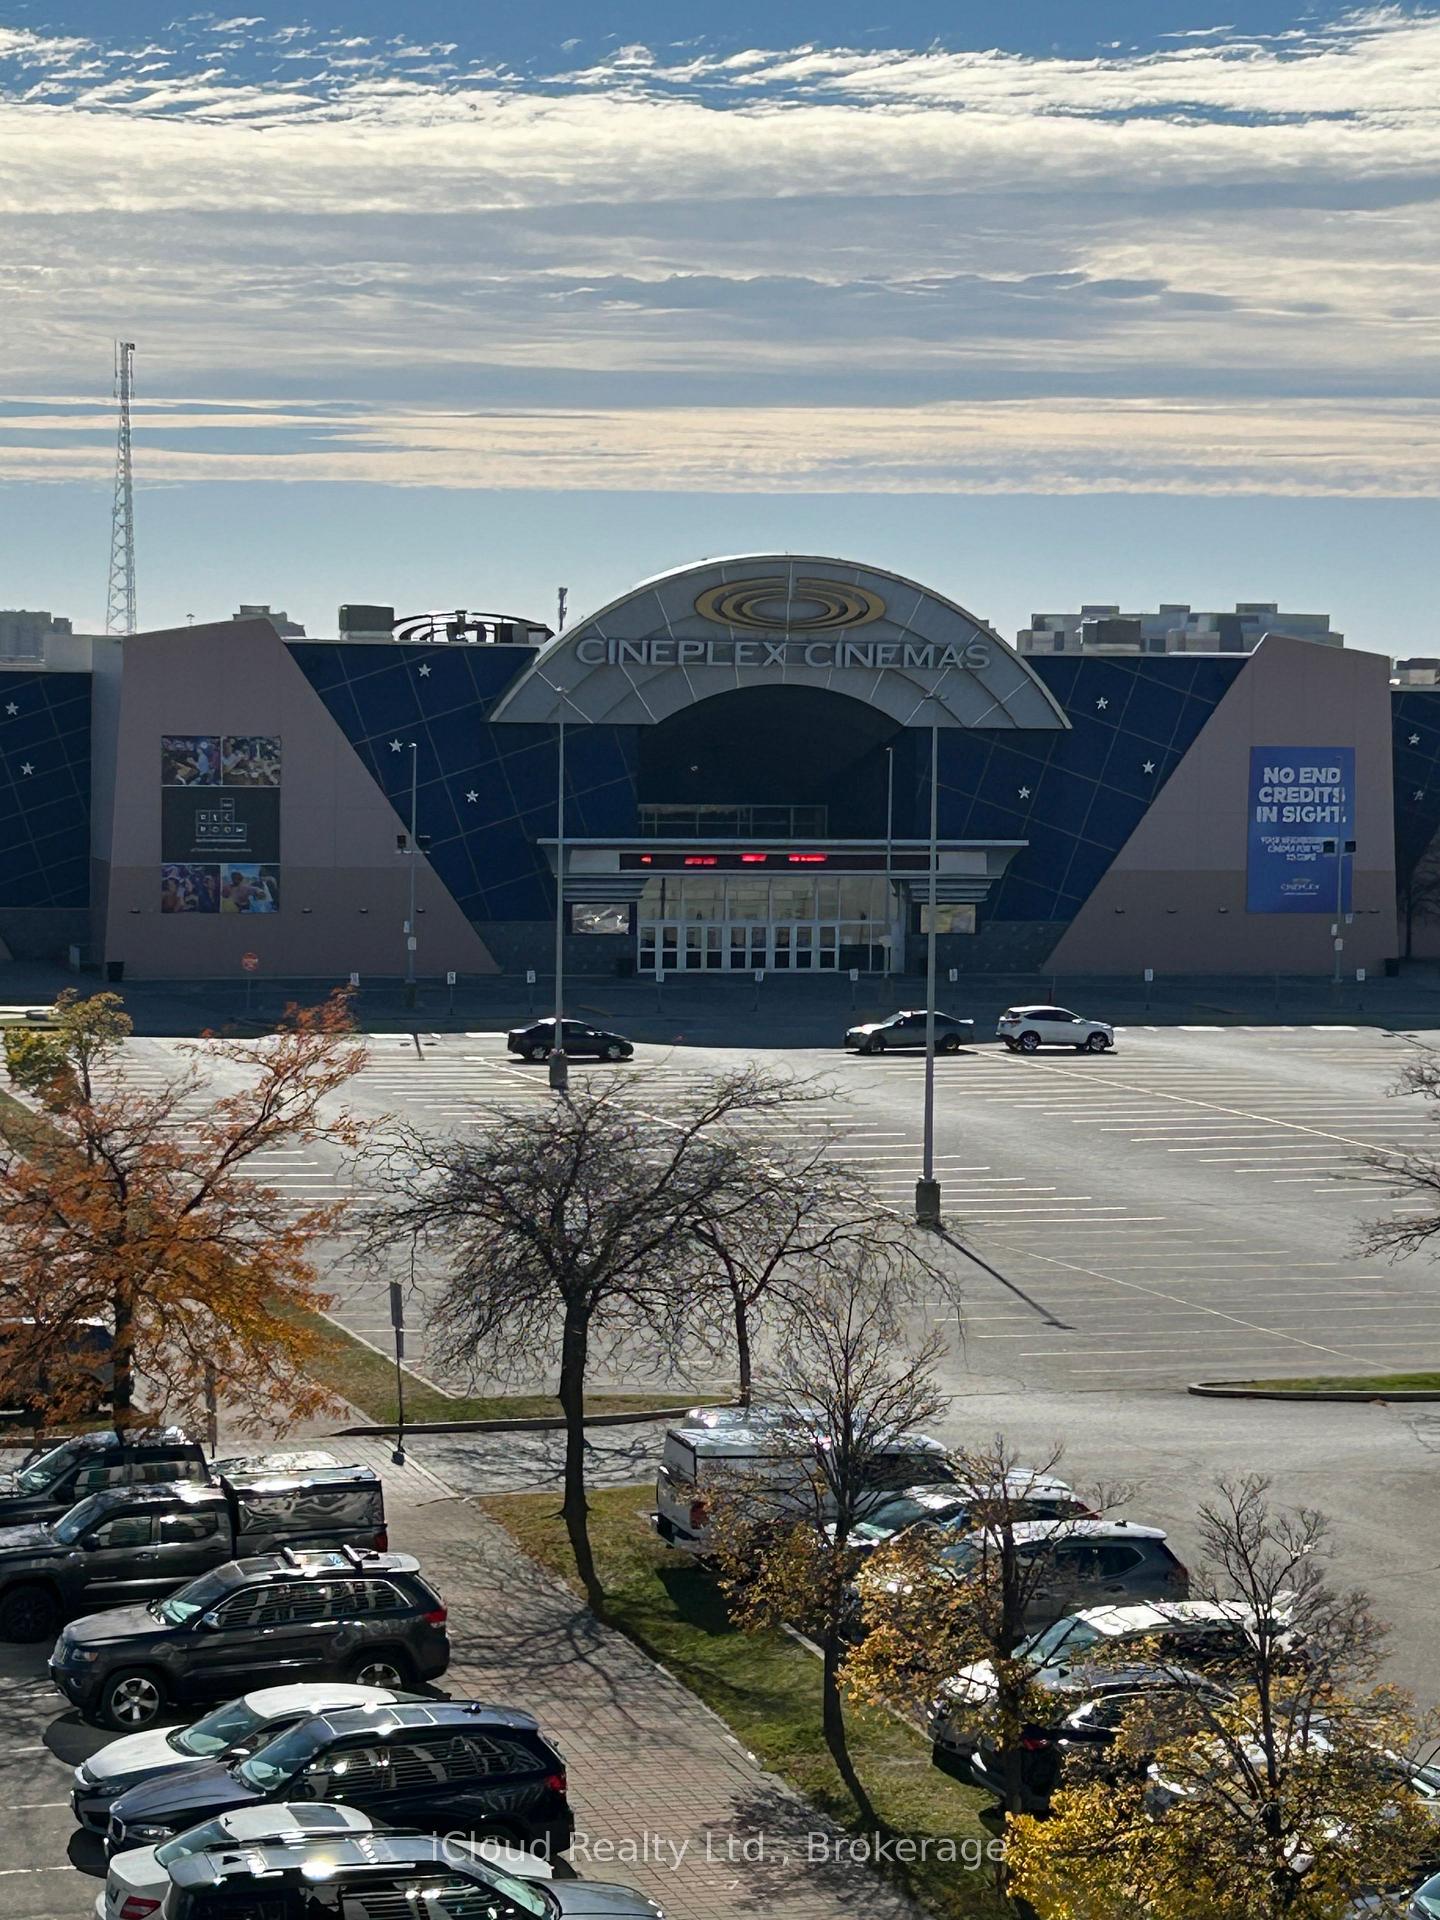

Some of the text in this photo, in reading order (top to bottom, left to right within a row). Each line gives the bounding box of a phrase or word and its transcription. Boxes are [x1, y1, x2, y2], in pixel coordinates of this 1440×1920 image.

[575, 637, 992, 670] CINEPLEX CINEMAS
[1263, 767, 1341, 784] NO END
[1258, 786, 1346, 804] CREDITS
[1256, 805, 1278, 823] IN
